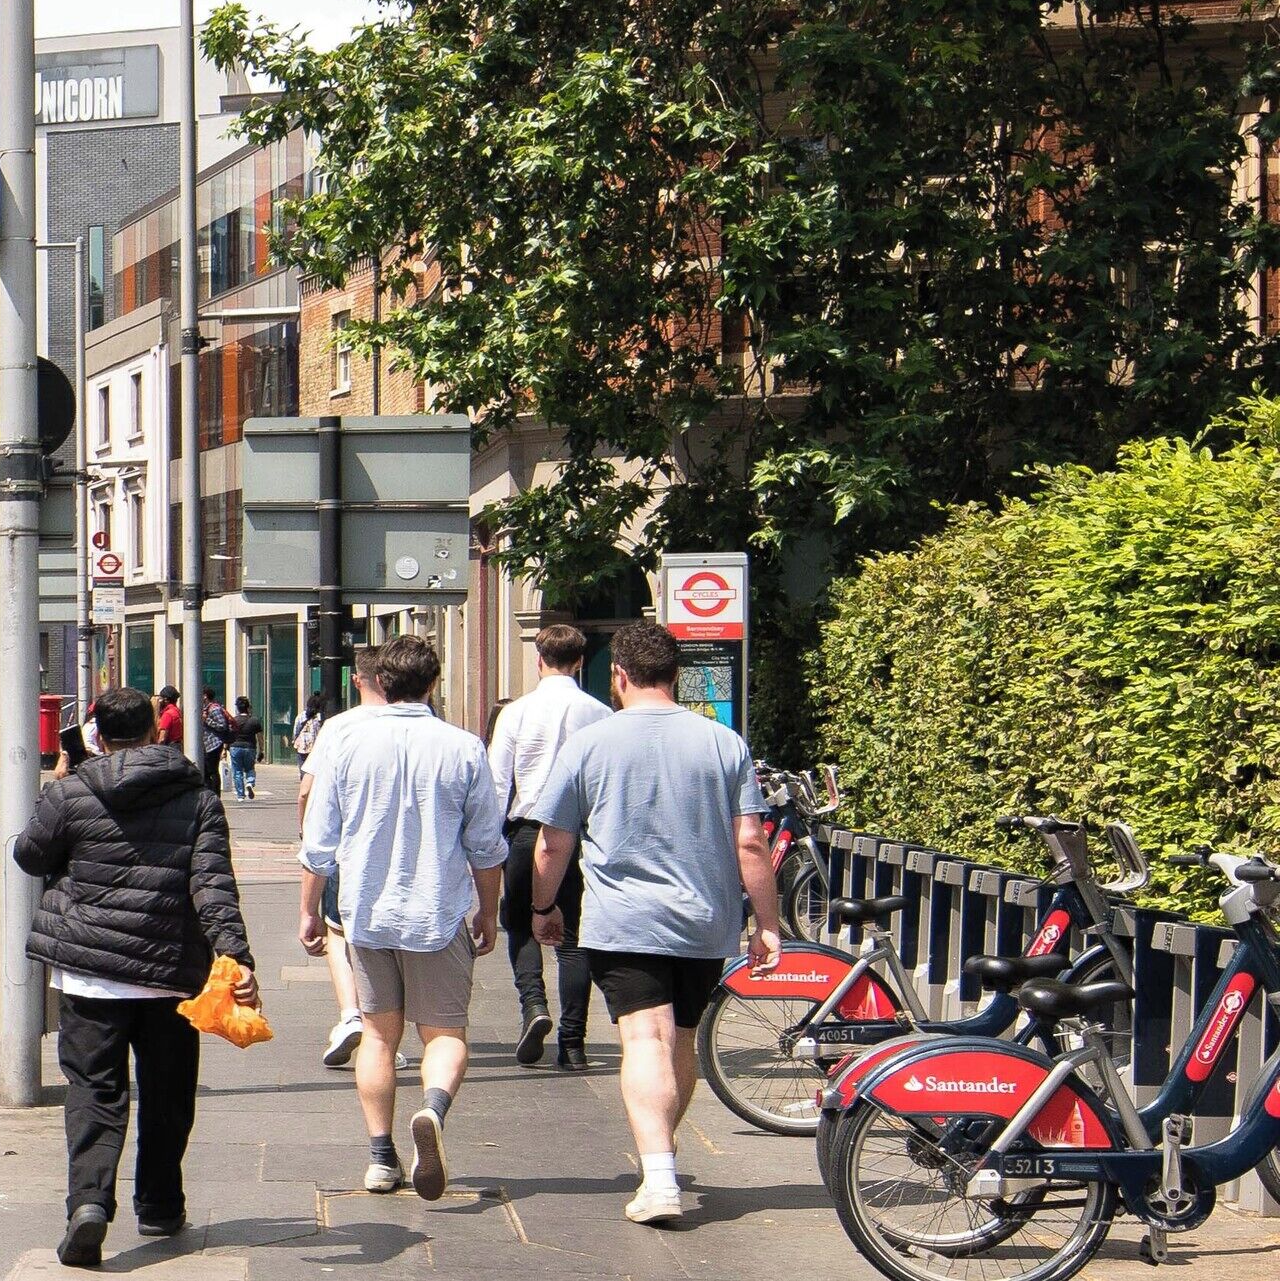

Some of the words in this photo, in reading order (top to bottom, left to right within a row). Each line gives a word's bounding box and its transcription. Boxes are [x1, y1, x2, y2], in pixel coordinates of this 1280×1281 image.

[96, 533, 105, 547] J
[1205, 1014, 1228, 1051] Santander
[925, 1076, 1017, 1093] Santander
